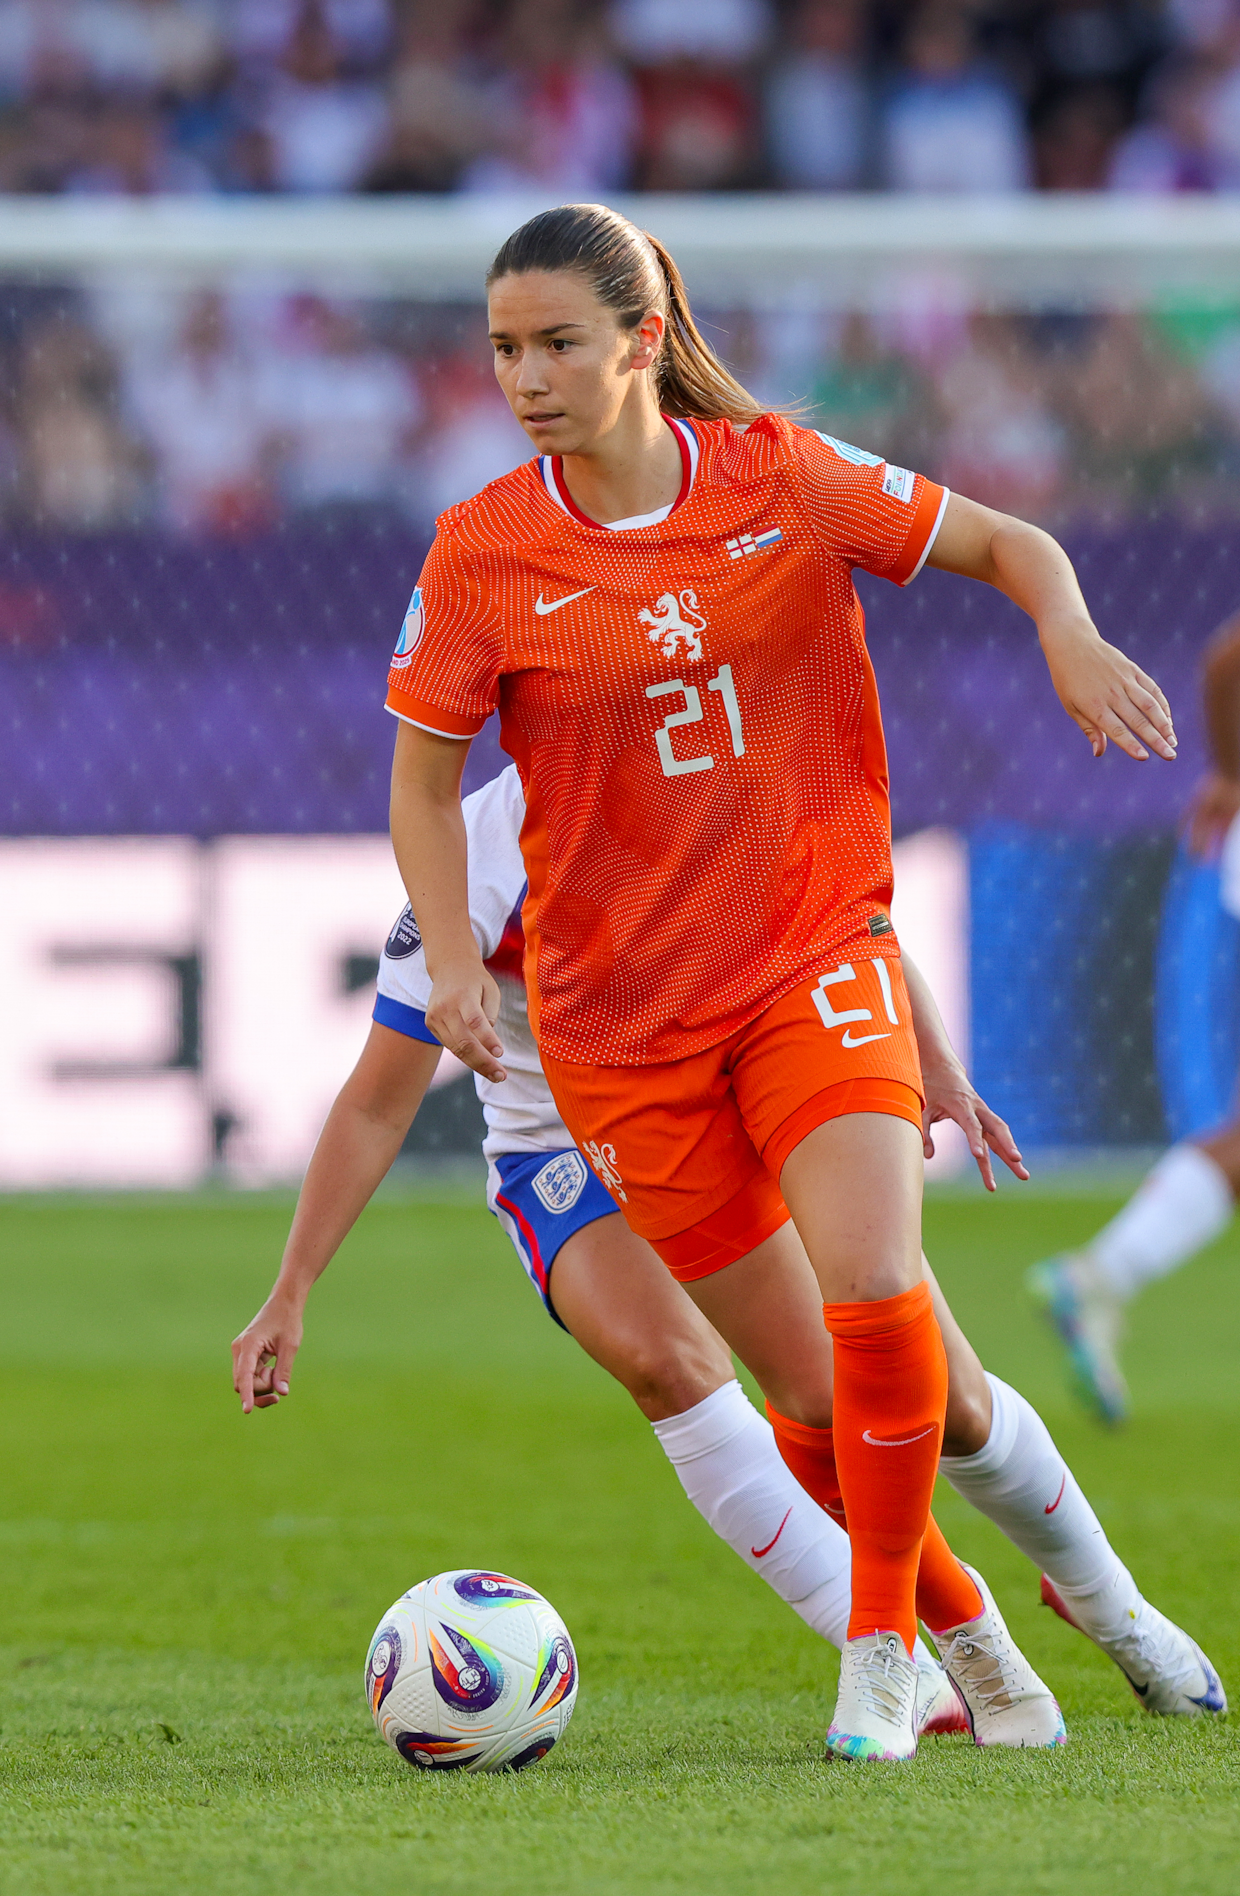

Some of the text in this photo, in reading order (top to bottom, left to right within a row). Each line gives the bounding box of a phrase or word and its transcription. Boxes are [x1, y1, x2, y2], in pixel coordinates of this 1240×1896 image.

[645, 664, 745, 772] 21
[397, 931, 412, 945] 2022
[810, 958, 899, 1029] 21
